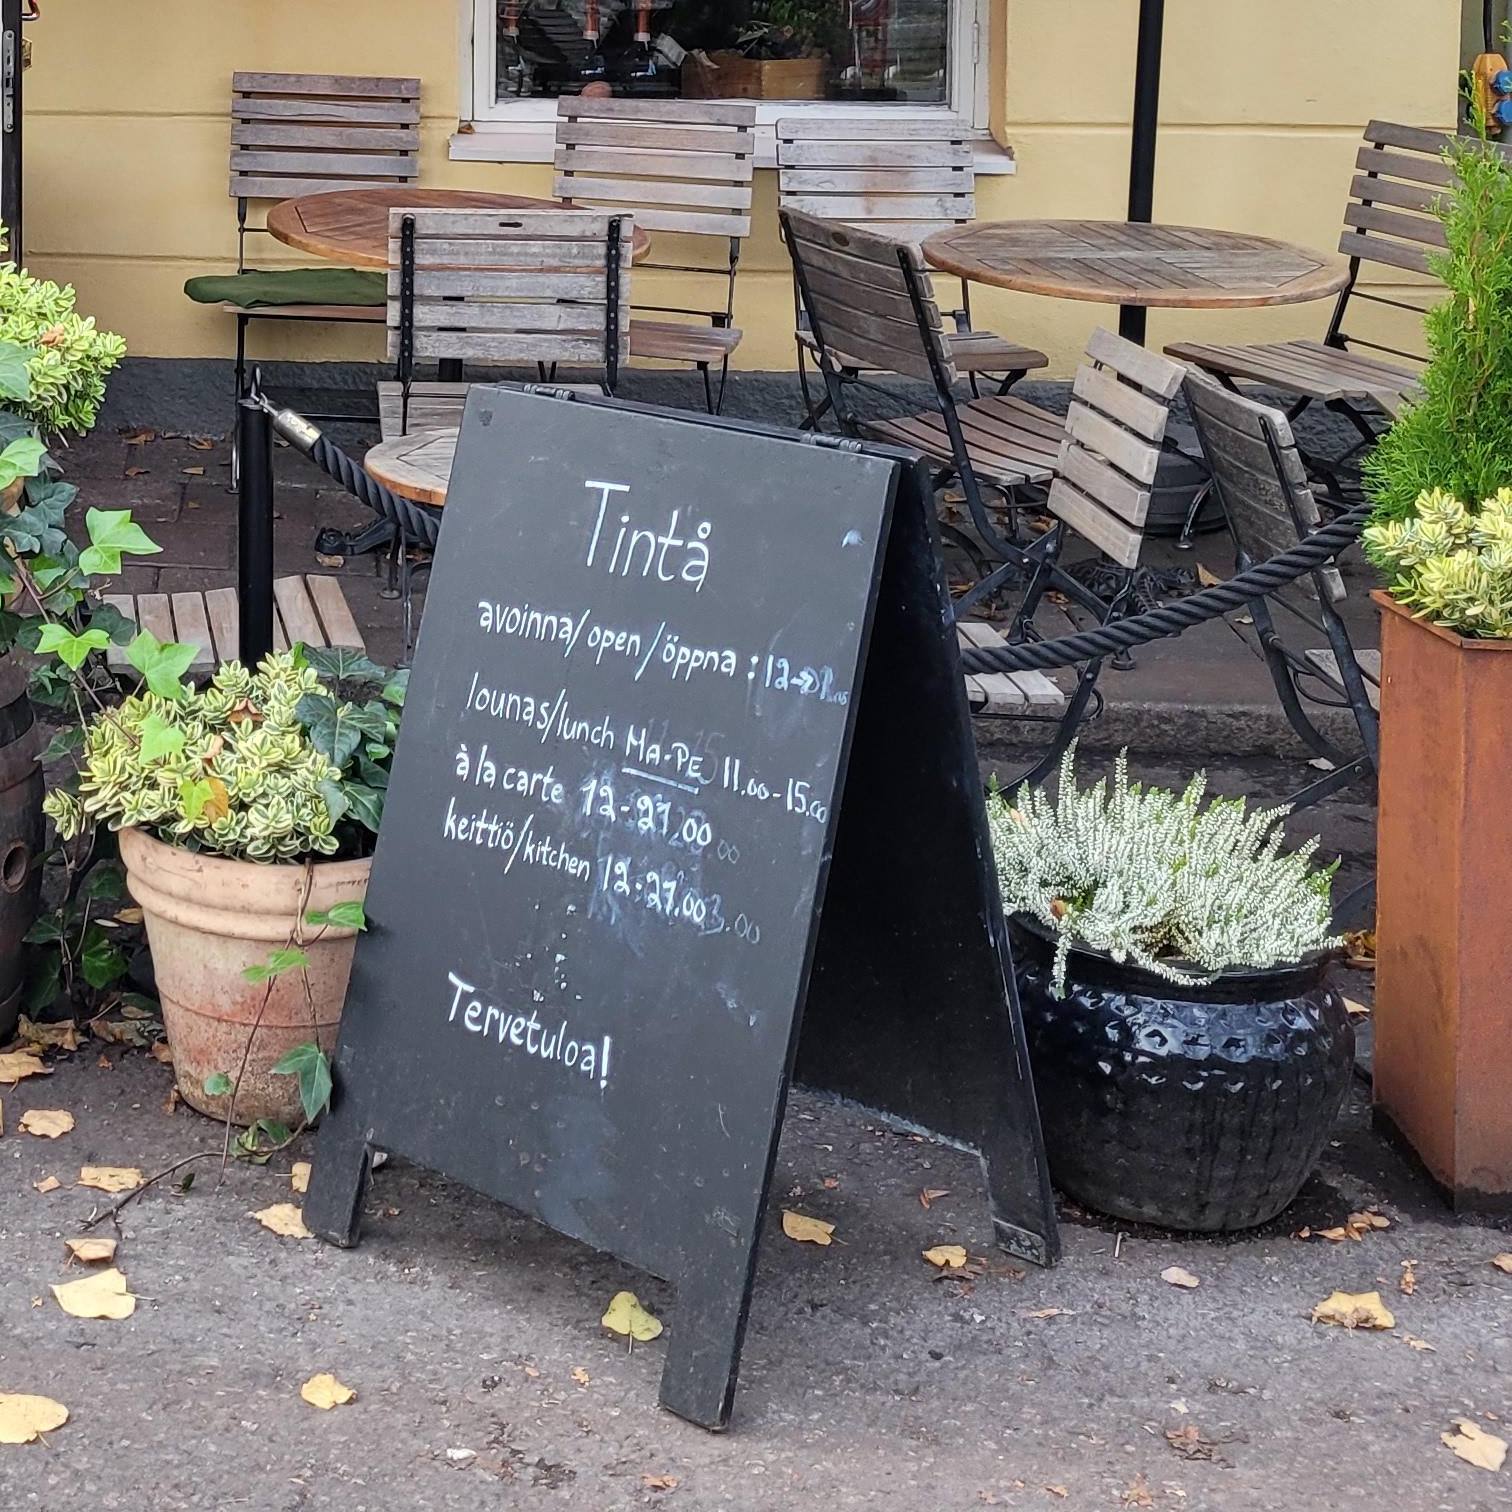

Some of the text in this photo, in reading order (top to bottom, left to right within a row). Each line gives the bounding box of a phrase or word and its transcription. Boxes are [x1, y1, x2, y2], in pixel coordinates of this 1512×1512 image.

[584, 479, 712, 593] Tintå
[455, 743, 471, 782] à
[475, 744, 497, 789] la
[502, 765, 565, 804] carte
[447, 970, 612, 1090] Tervetuloa!
